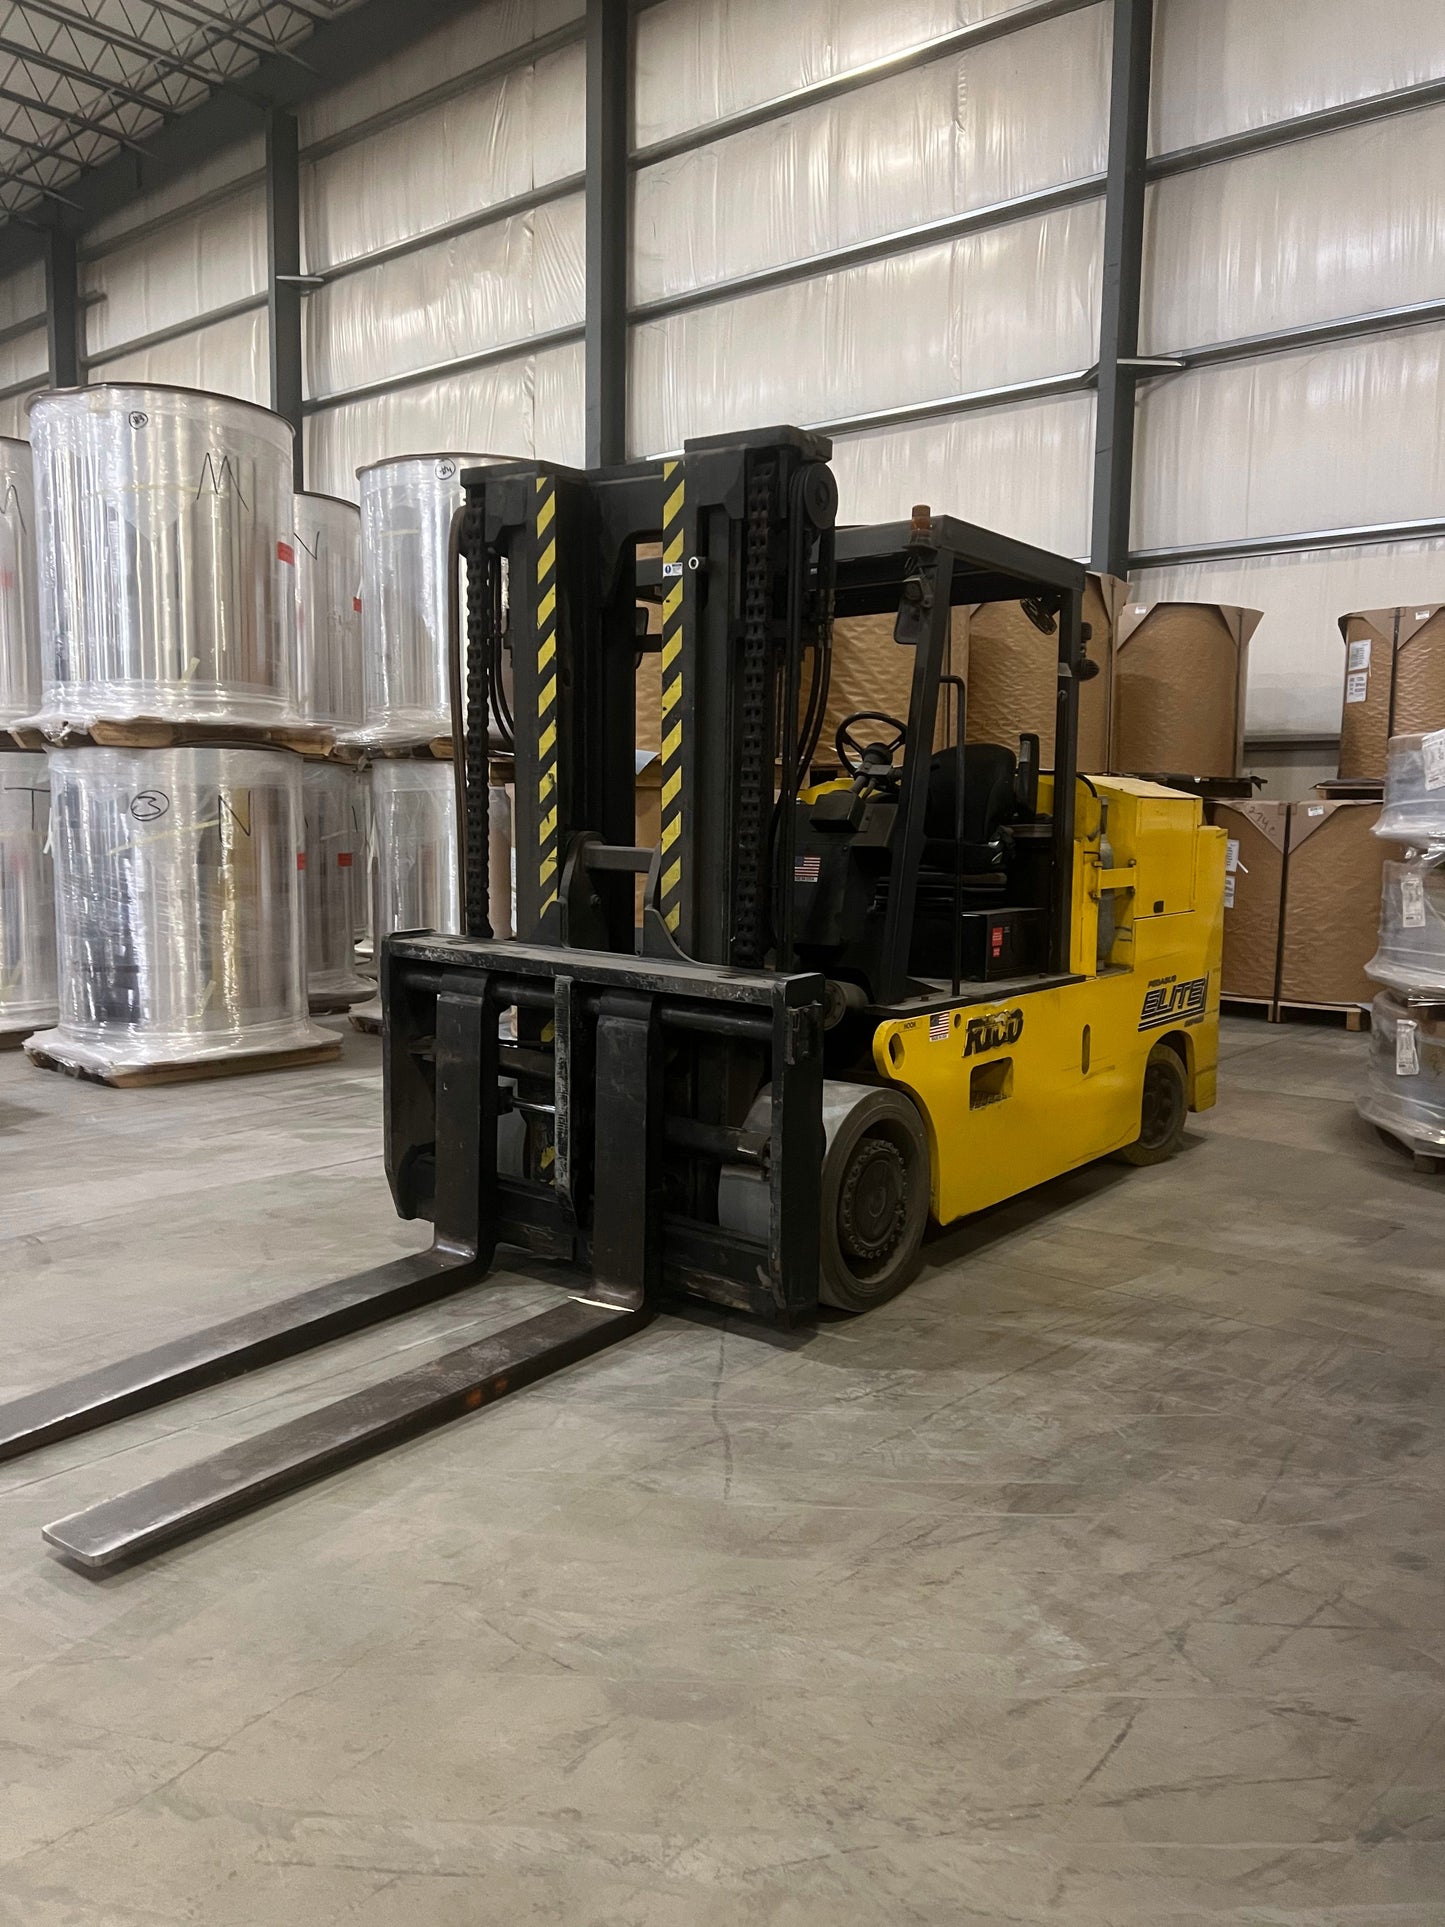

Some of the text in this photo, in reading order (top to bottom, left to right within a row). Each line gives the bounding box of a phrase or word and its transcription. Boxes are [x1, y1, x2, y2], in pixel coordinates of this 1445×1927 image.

[131, 793, 165, 819] 3
[218, 790, 251, 843] N
[1140, 978, 1206, 1020] ELITE
[962, 1008, 1024, 1058] RICO
